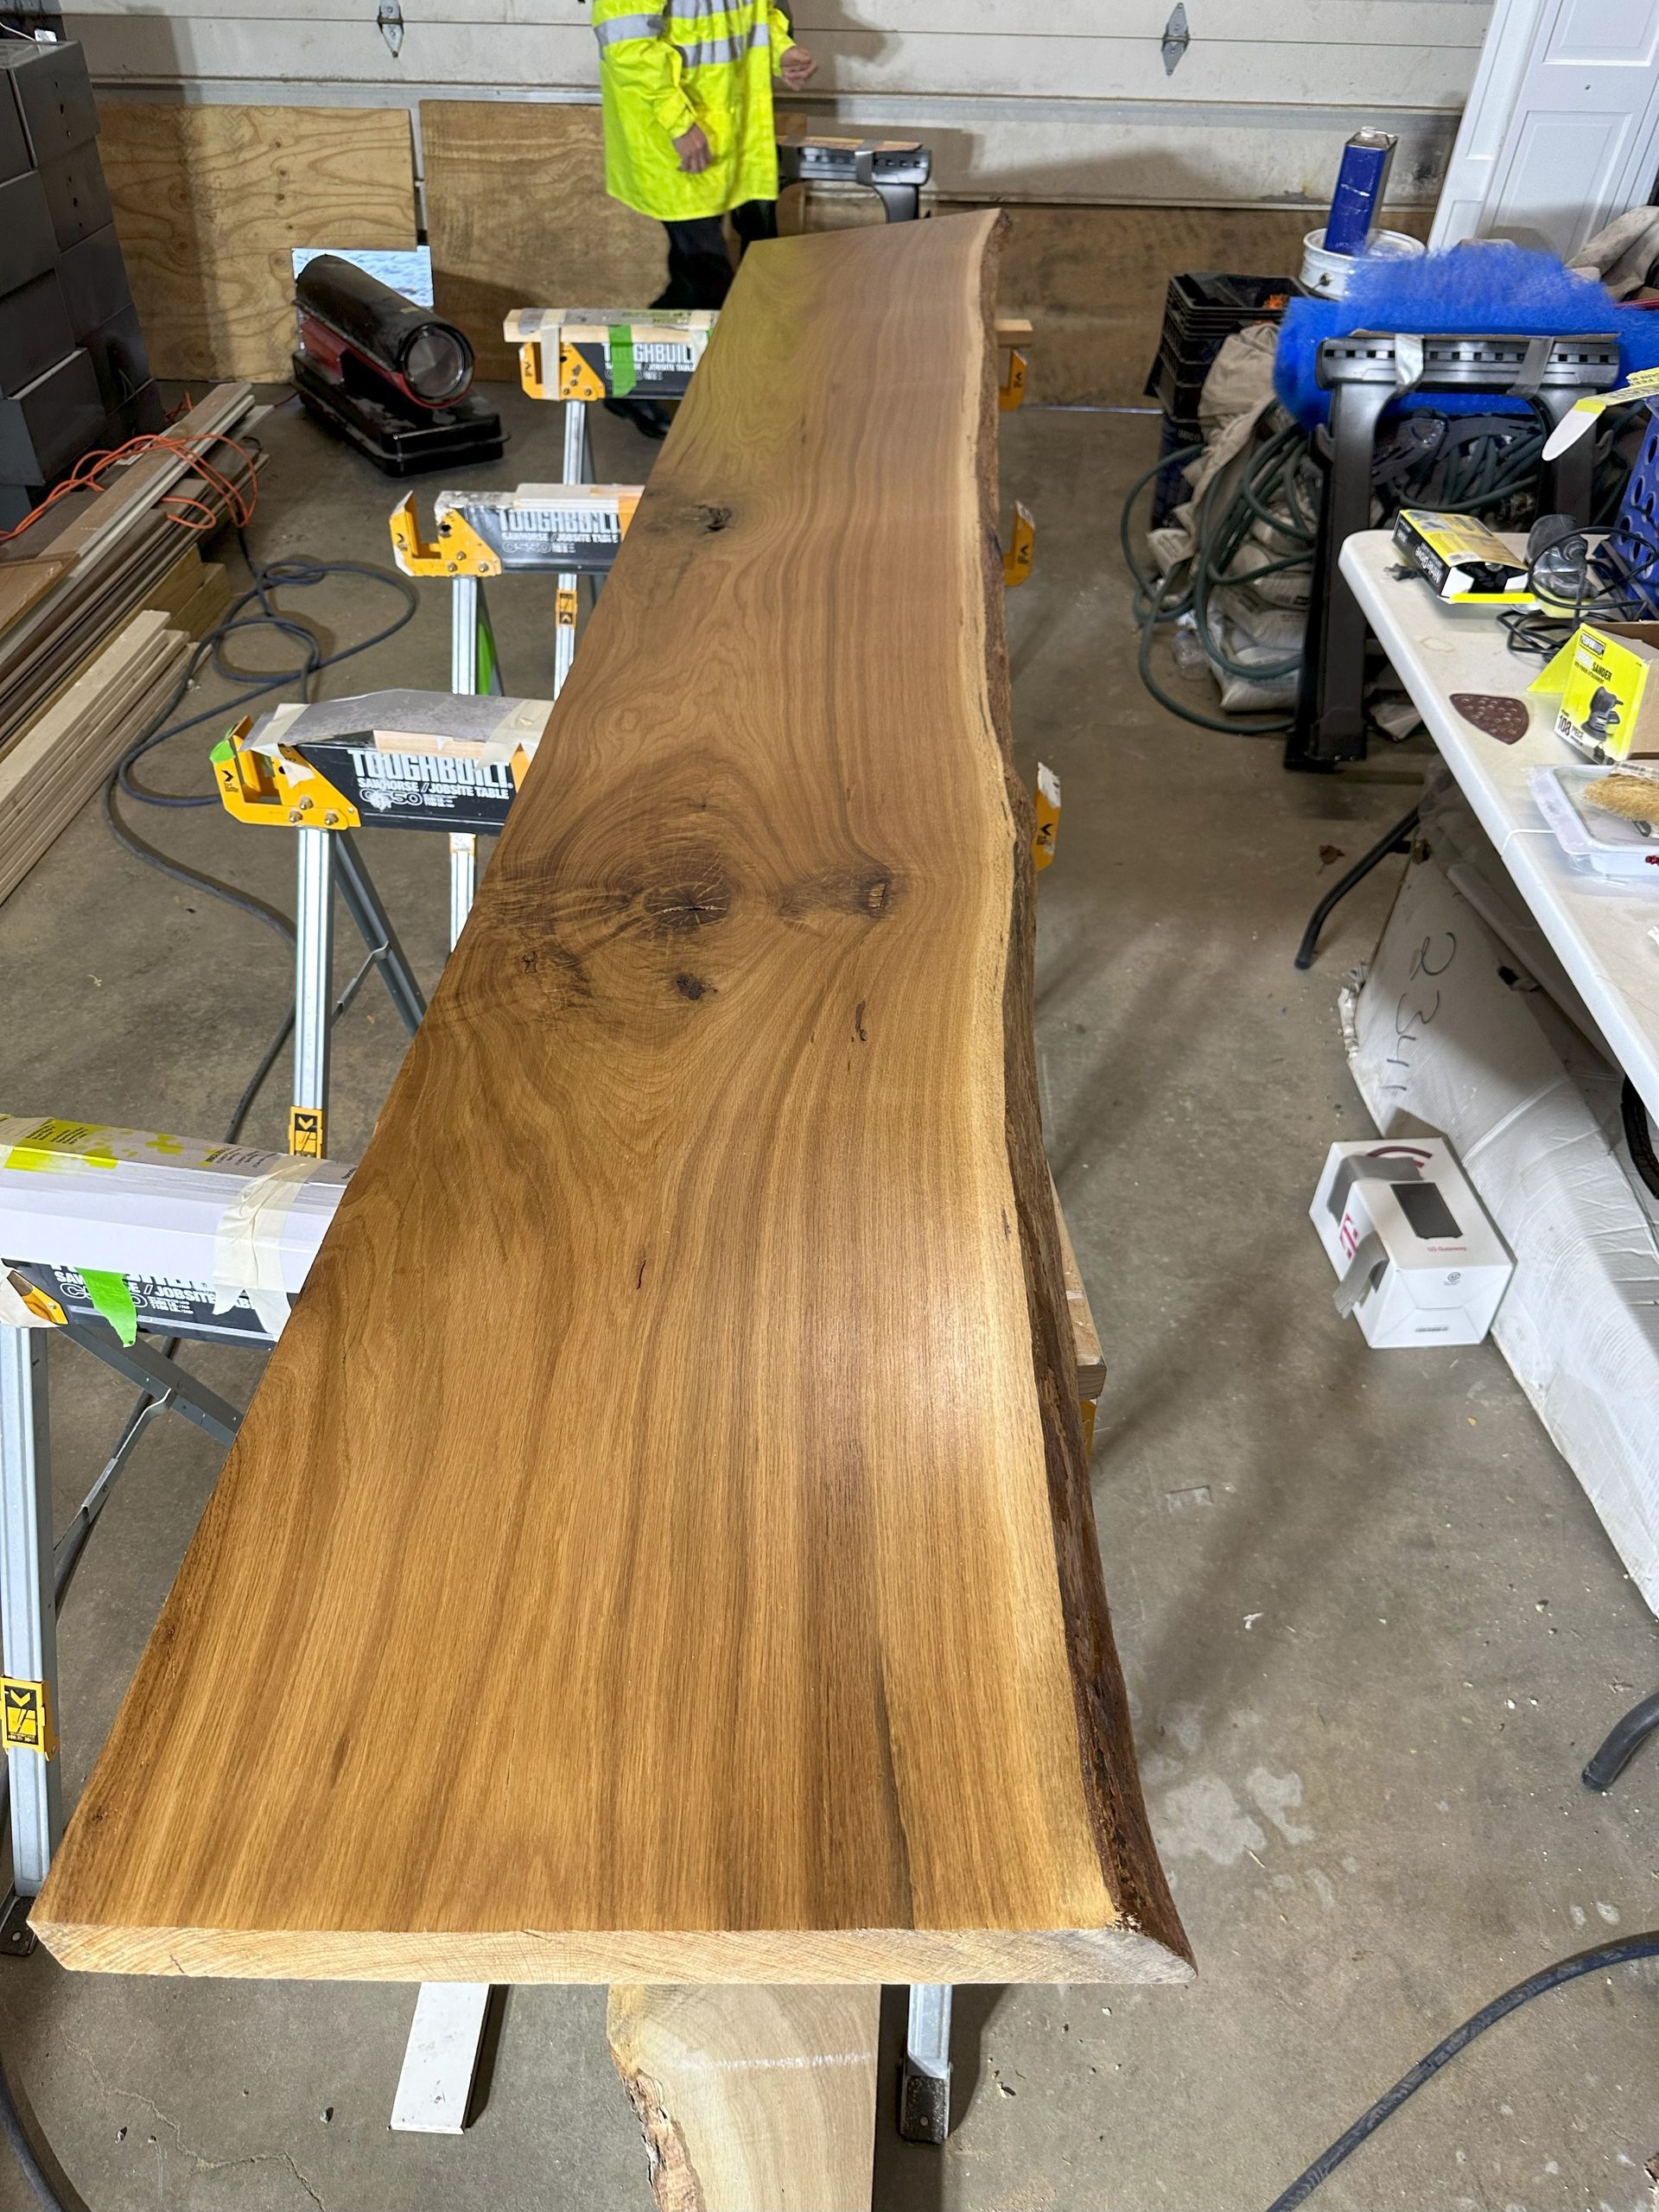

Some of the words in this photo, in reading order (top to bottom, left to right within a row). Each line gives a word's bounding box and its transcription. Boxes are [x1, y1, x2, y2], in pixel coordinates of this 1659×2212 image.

[601, 343, 695, 363] TGHBUIL
[1592, 662, 1612, 683] SANDER
[1558, 715, 1571, 736] 108
[347, 749, 509, 788] TOUGHBUILT
[358, 778, 420, 792] SAWHORSE
[429, 783, 474, 797] JOBSITE
[474, 786, 510, 800] TABLE
[155, 1286, 216, 1305] JOBSITE
